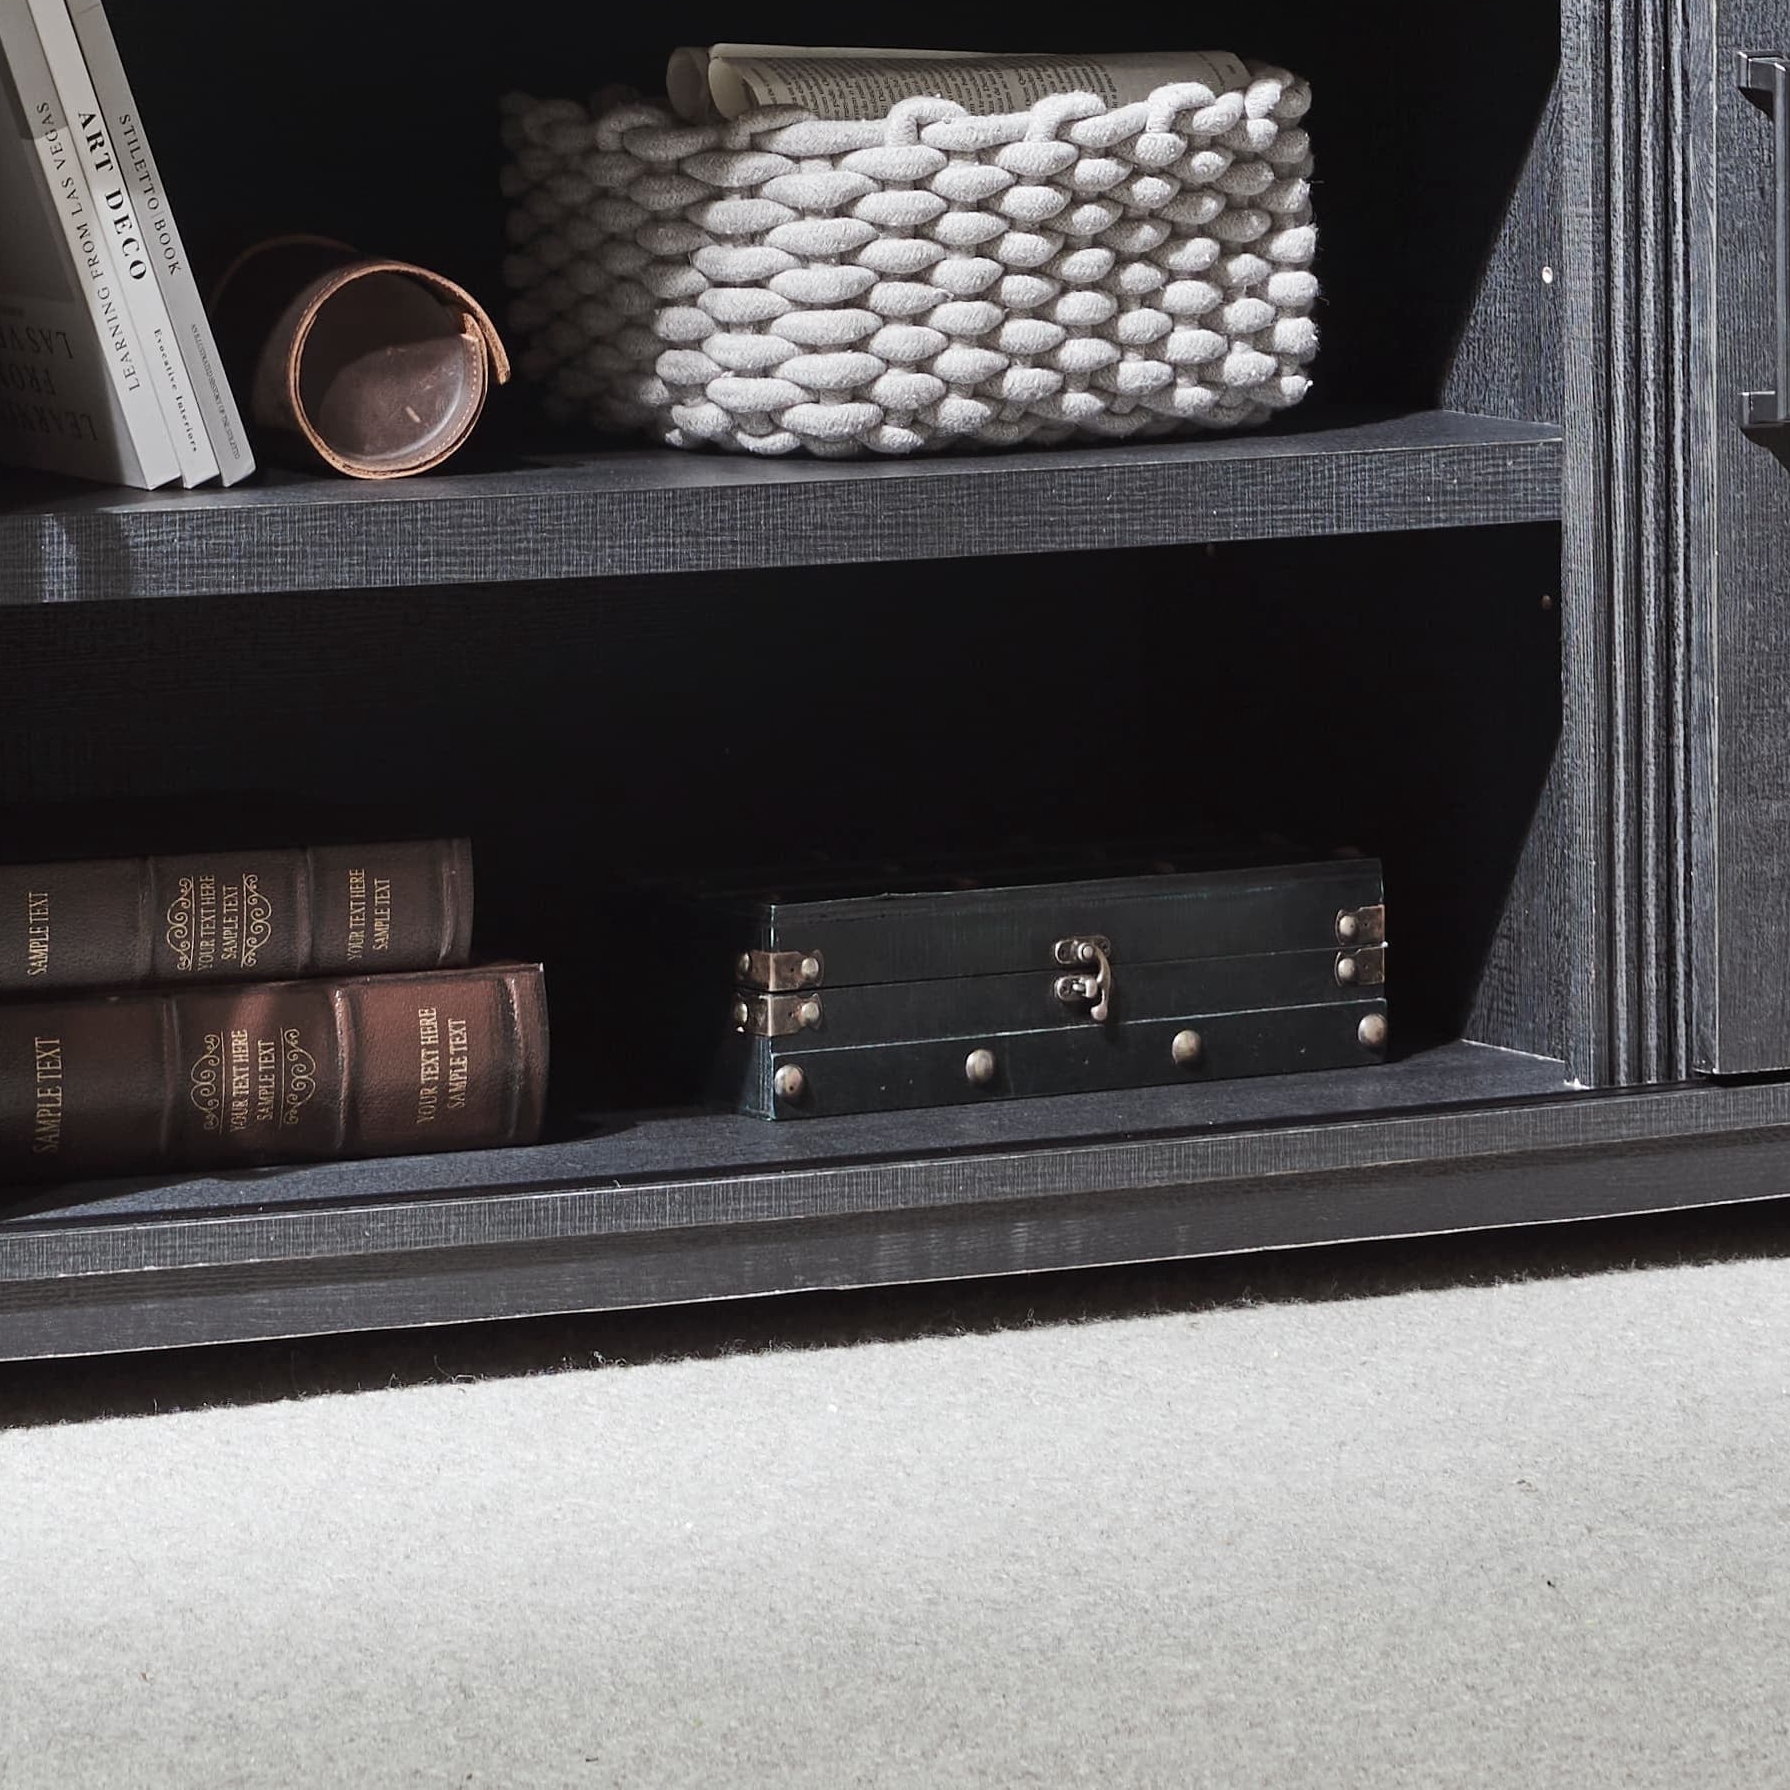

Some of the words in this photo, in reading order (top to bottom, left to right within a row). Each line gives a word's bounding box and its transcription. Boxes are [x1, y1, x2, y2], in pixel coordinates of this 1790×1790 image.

[37, 101, 66, 170] VEGAS
[61, 177, 83, 216] LAS
[78, 112, 114, 172] ART
[105, 188, 147, 280] DECO
[119, 114, 160, 210] STILETTO
[154, 219, 181, 276] BOOK
[76, 223, 104, 280] FROM
[97, 287, 140, 392] LEARNING
[154, 328, 178, 391] Evocative
[175, 395, 197, 452] Interiors
[200, 874, 216, 906] HERE
[223, 884, 238, 914] TEXT
[349, 868, 365, 899] HERE
[374, 878, 391, 910] TEXT
[28, 892, 49, 924] TEXT
[200, 906, 216, 938] TEXT
[349, 900, 366, 928] TEXT
[221, 916, 238, 960] SAMPLE
[347, 929, 365, 961] YOUR
[373, 911, 390, 950] SAMPLE
[27, 926, 49, 976] SAMPLE
[198, 939, 215, 971] YOUR
[418, 1007, 438, 1045] HERE
[448, 1018, 468, 1055] TEXT
[35, 1037, 62, 1083] TEXT
[231, 1028, 249, 1063] HERE
[258, 1039, 275, 1072] TEXT
[420, 1046, 440, 1082] TEXT
[232, 1063, 250, 1097] TEXT
[257, 1073, 275, 1121] SAMPLE
[447, 1056, 468, 1109] SAMPLE
[33, 1086, 62, 1153] SAMPLE
[230, 1098, 249, 1132] YOUR
[416, 1083, 438, 1124] YOUR
